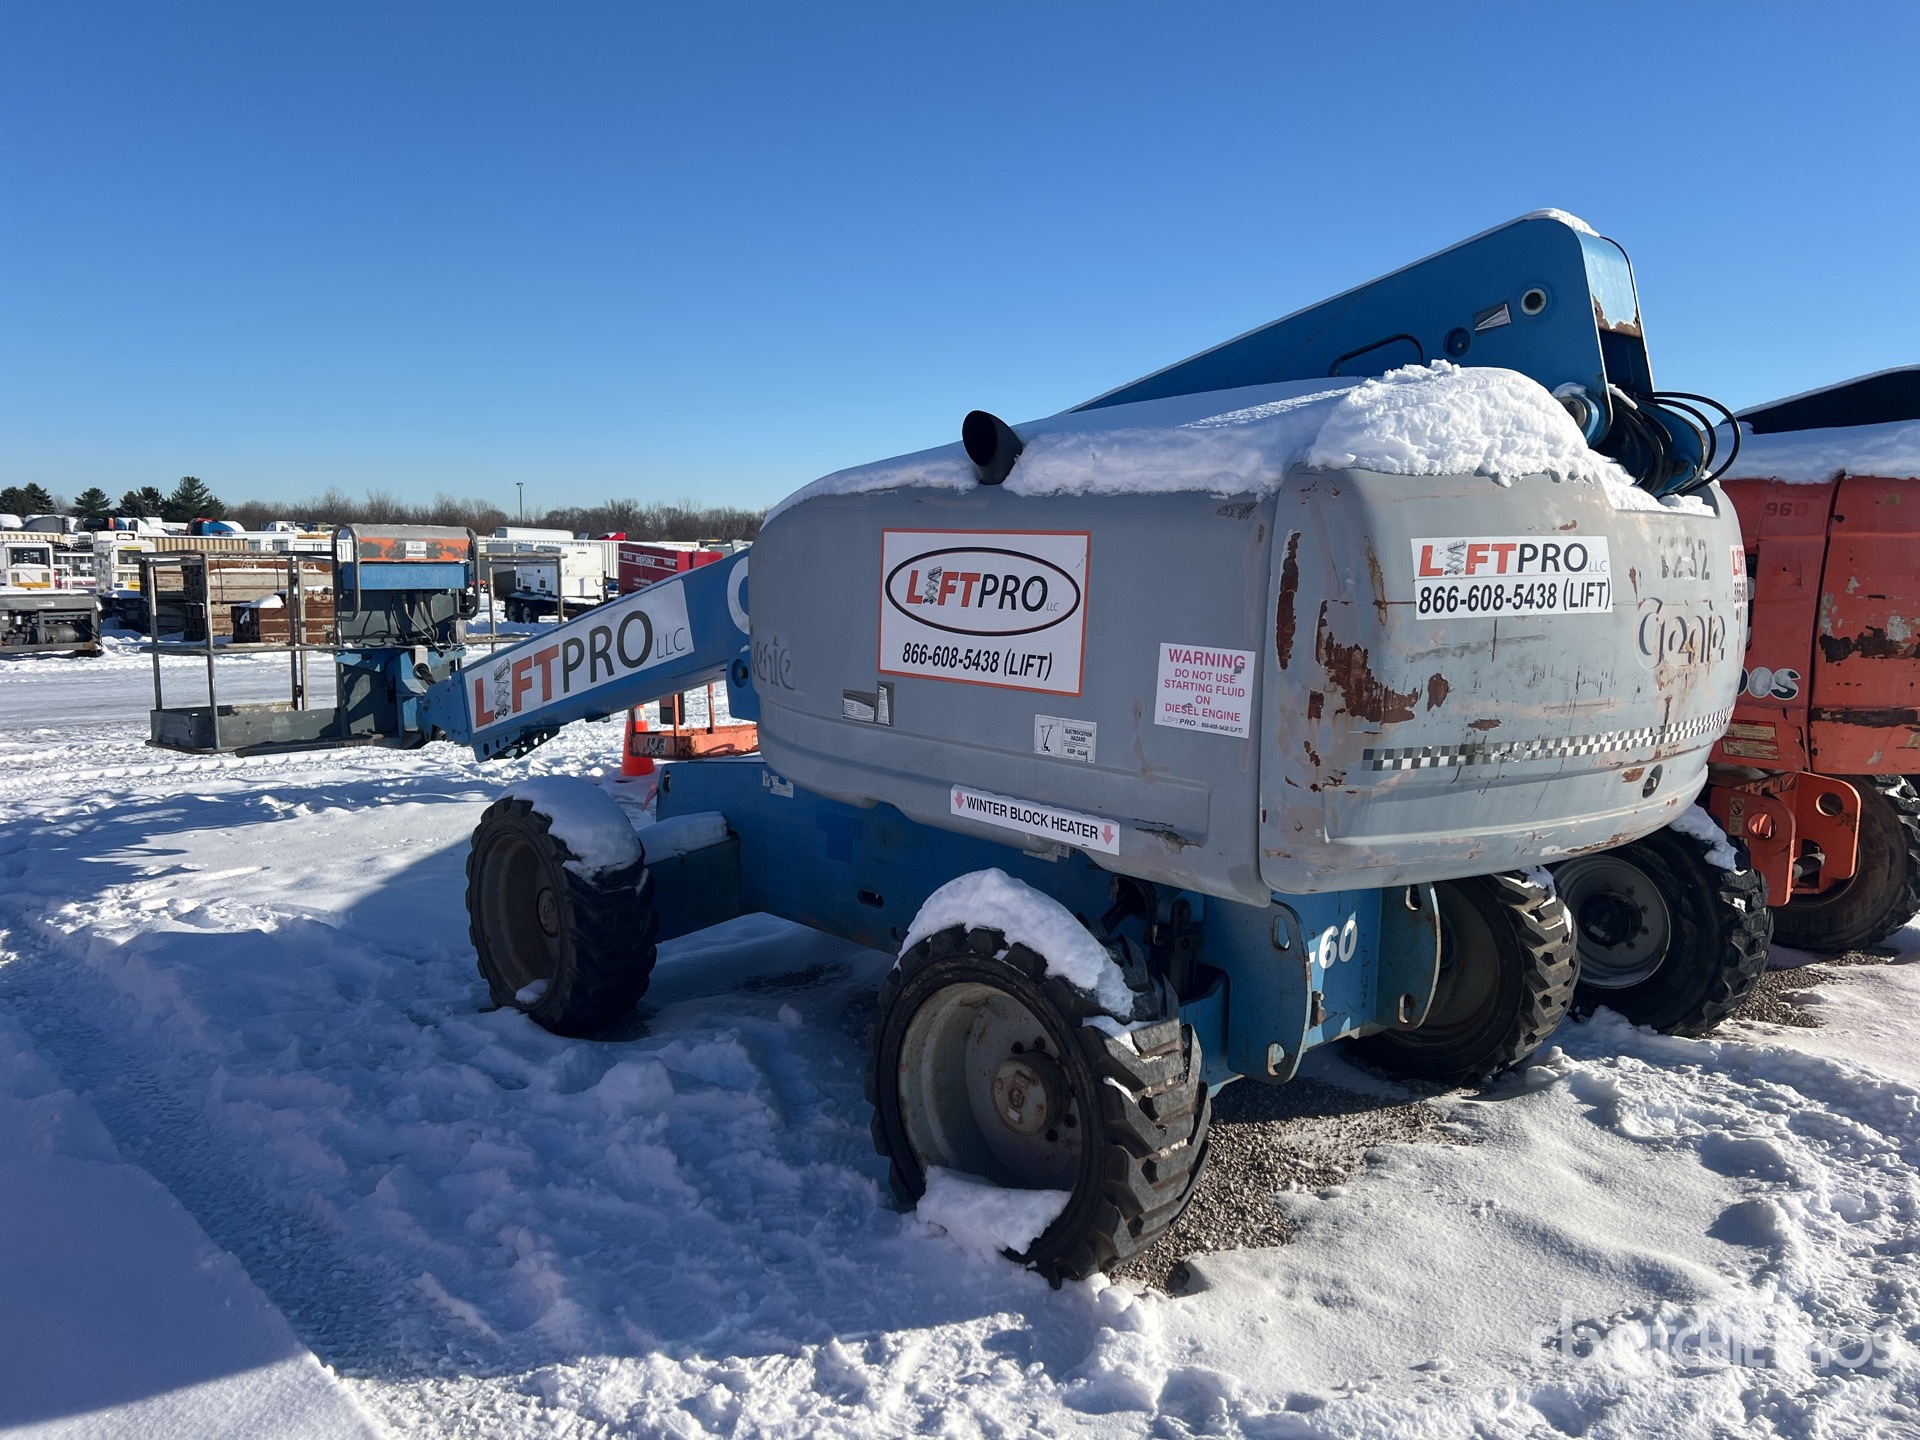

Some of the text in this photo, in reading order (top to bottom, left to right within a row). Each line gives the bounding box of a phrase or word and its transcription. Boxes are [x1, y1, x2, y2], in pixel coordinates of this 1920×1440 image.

[1588, 560, 1608, 573] LLC
[1418, 577, 1611, 614] 866-608-5438 (LIFT)
[655, 627, 686, 659] LLC
[902, 642, 1053, 681] 866-608-5438 (LIFT)
[1168, 648, 1246, 670] WARNING
[1174, 668, 1236, 684] DO NOT USE
[1164, 679, 1245, 698] STARTING FLUID
[1195, 695, 1211, 706] ON
[1165, 702, 1241, 722] DIESEL ENGINE
[966, 795, 1098, 840] WINTER BLOCK HEATER
